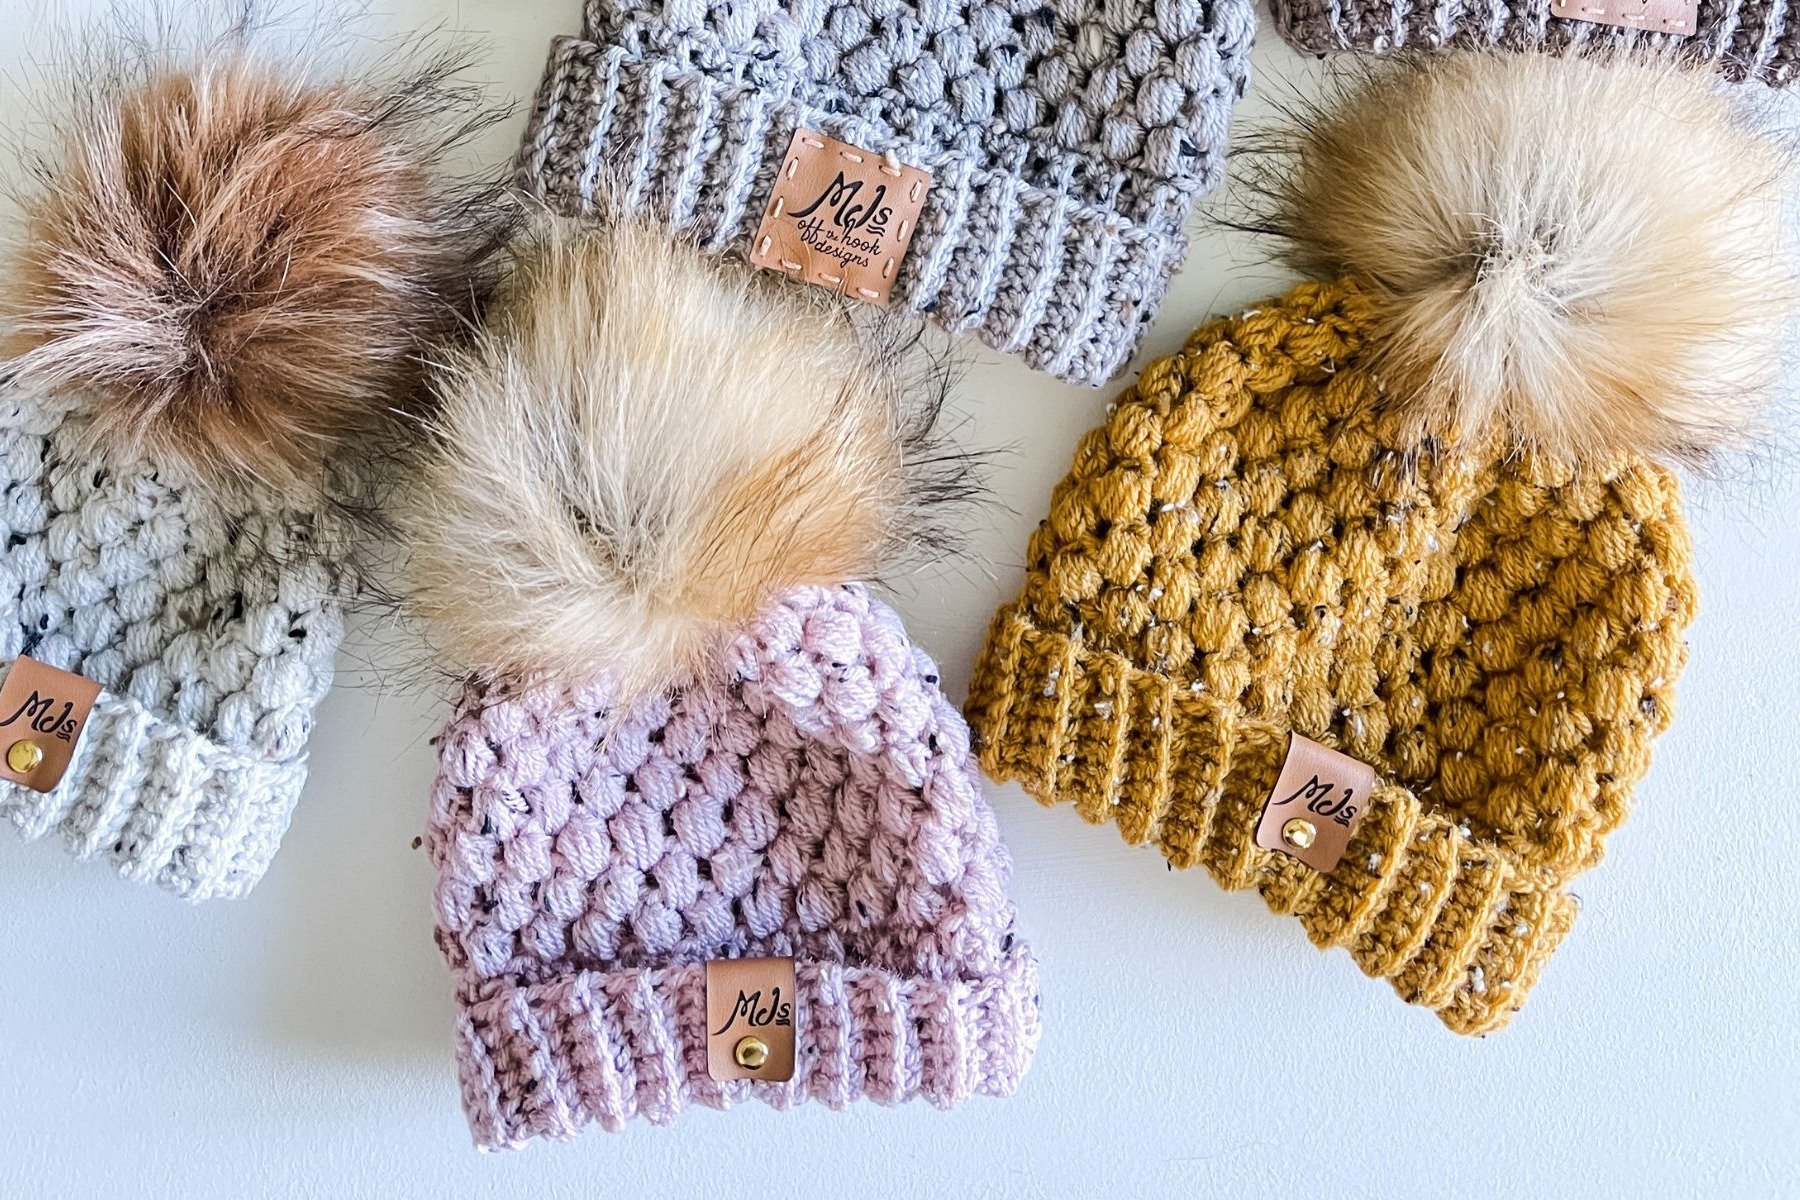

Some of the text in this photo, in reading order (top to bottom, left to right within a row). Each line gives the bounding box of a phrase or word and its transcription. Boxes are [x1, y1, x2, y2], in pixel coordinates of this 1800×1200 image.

[797, 216, 824, 245] off
[841, 218, 882, 256] hook
[814, 240, 869, 268] designs
